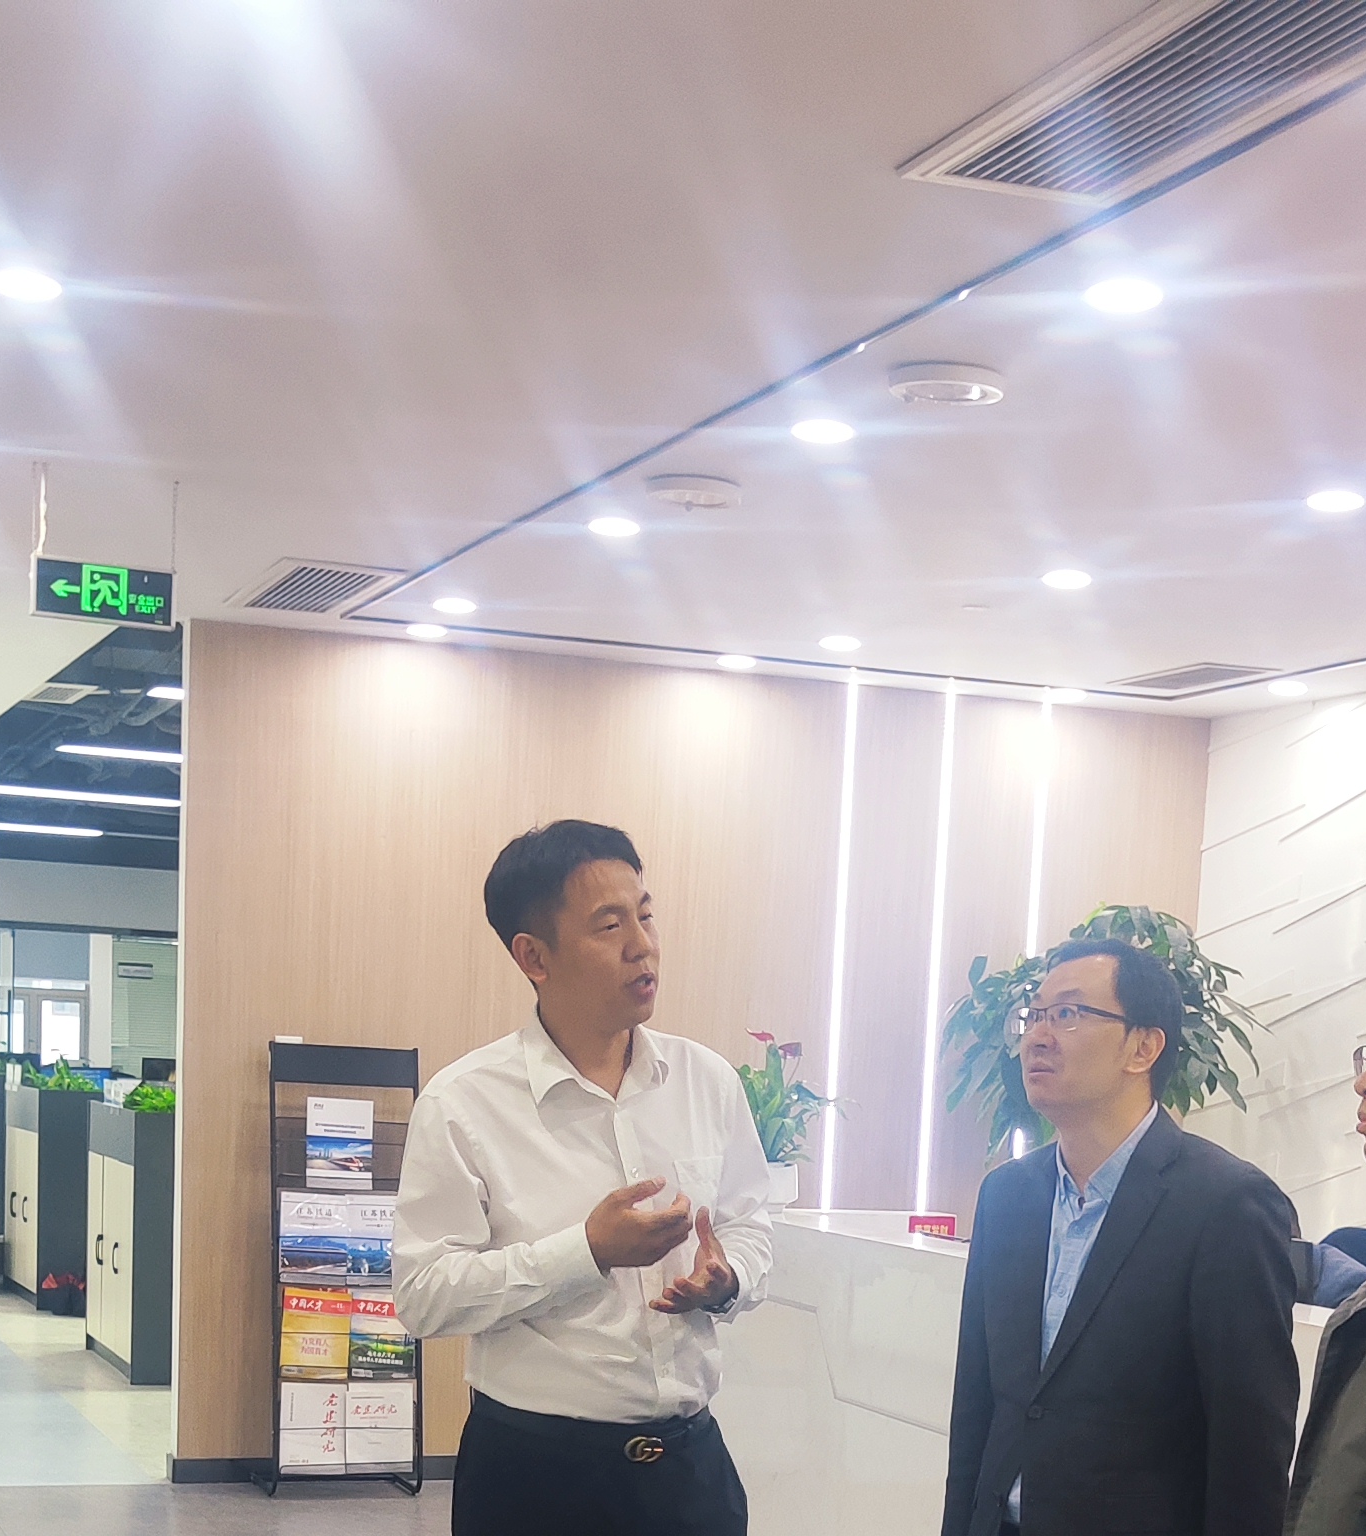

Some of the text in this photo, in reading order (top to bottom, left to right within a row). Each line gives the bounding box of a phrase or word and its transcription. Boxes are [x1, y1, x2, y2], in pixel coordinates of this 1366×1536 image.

[136, 604, 158, 614] EXIT
[289, 1297, 324, 1312] 中国人才
[357, 1301, 390, 1316] 中国人才
